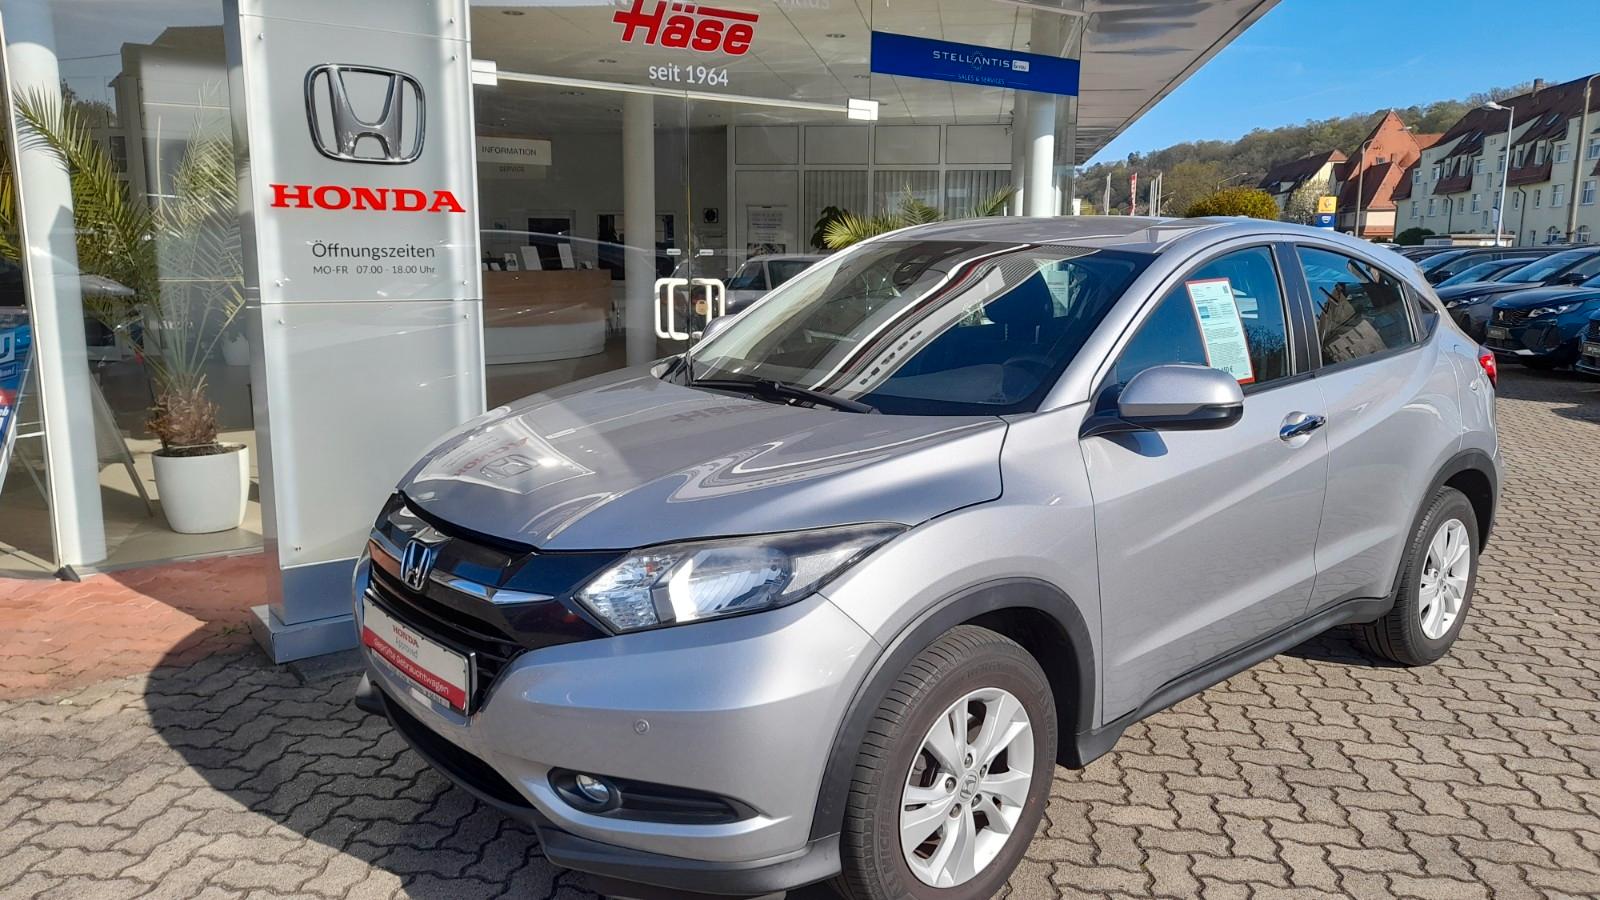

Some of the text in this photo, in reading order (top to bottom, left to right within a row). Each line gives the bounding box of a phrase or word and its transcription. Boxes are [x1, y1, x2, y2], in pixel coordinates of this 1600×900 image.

[613, 0, 758, 55] Häse
[932, 50, 1010, 68] STELLANTIS
[649, 63, 728, 86] seit 1964
[481, 145, 537, 157] INFORMATION
[269, 184, 466, 213] HONDA
[312, 240, 436, 260] Öffnungszeiten
[313, 265, 349, 275] MO-FR
[356, 265, 383, 274] 07.00
[392, 265, 417, 274] 18.00
[419, 265, 436, 274] Uhr
[392, 625, 419, 649] HONDA
